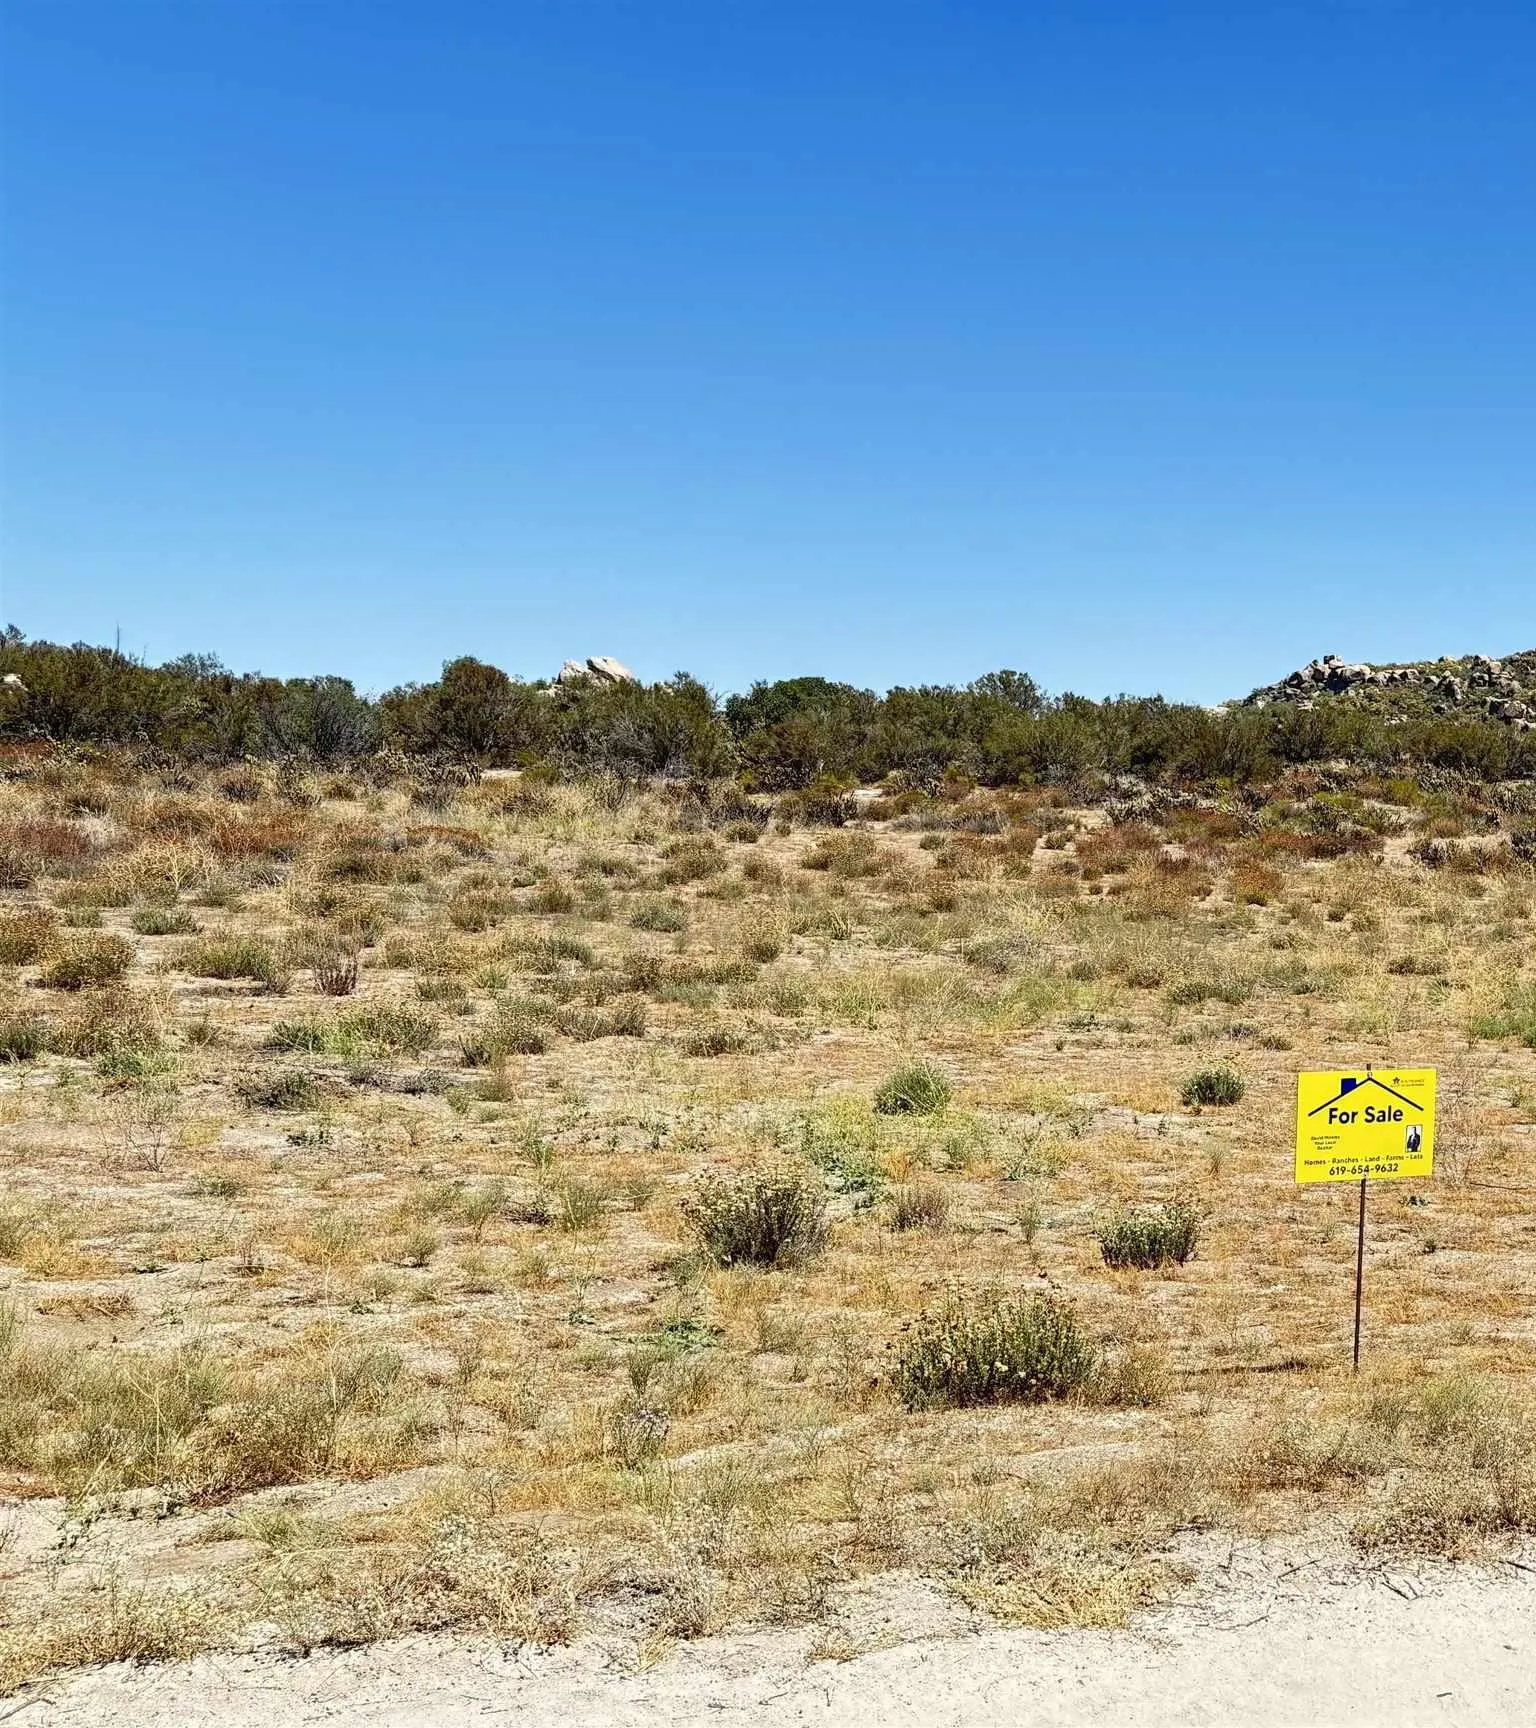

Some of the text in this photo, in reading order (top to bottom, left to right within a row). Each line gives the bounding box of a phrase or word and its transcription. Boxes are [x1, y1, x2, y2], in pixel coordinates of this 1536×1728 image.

[1328, 1105, 1404, 1125] For Sale
[1329, 1163, 1399, 1176] 619-654-9632
